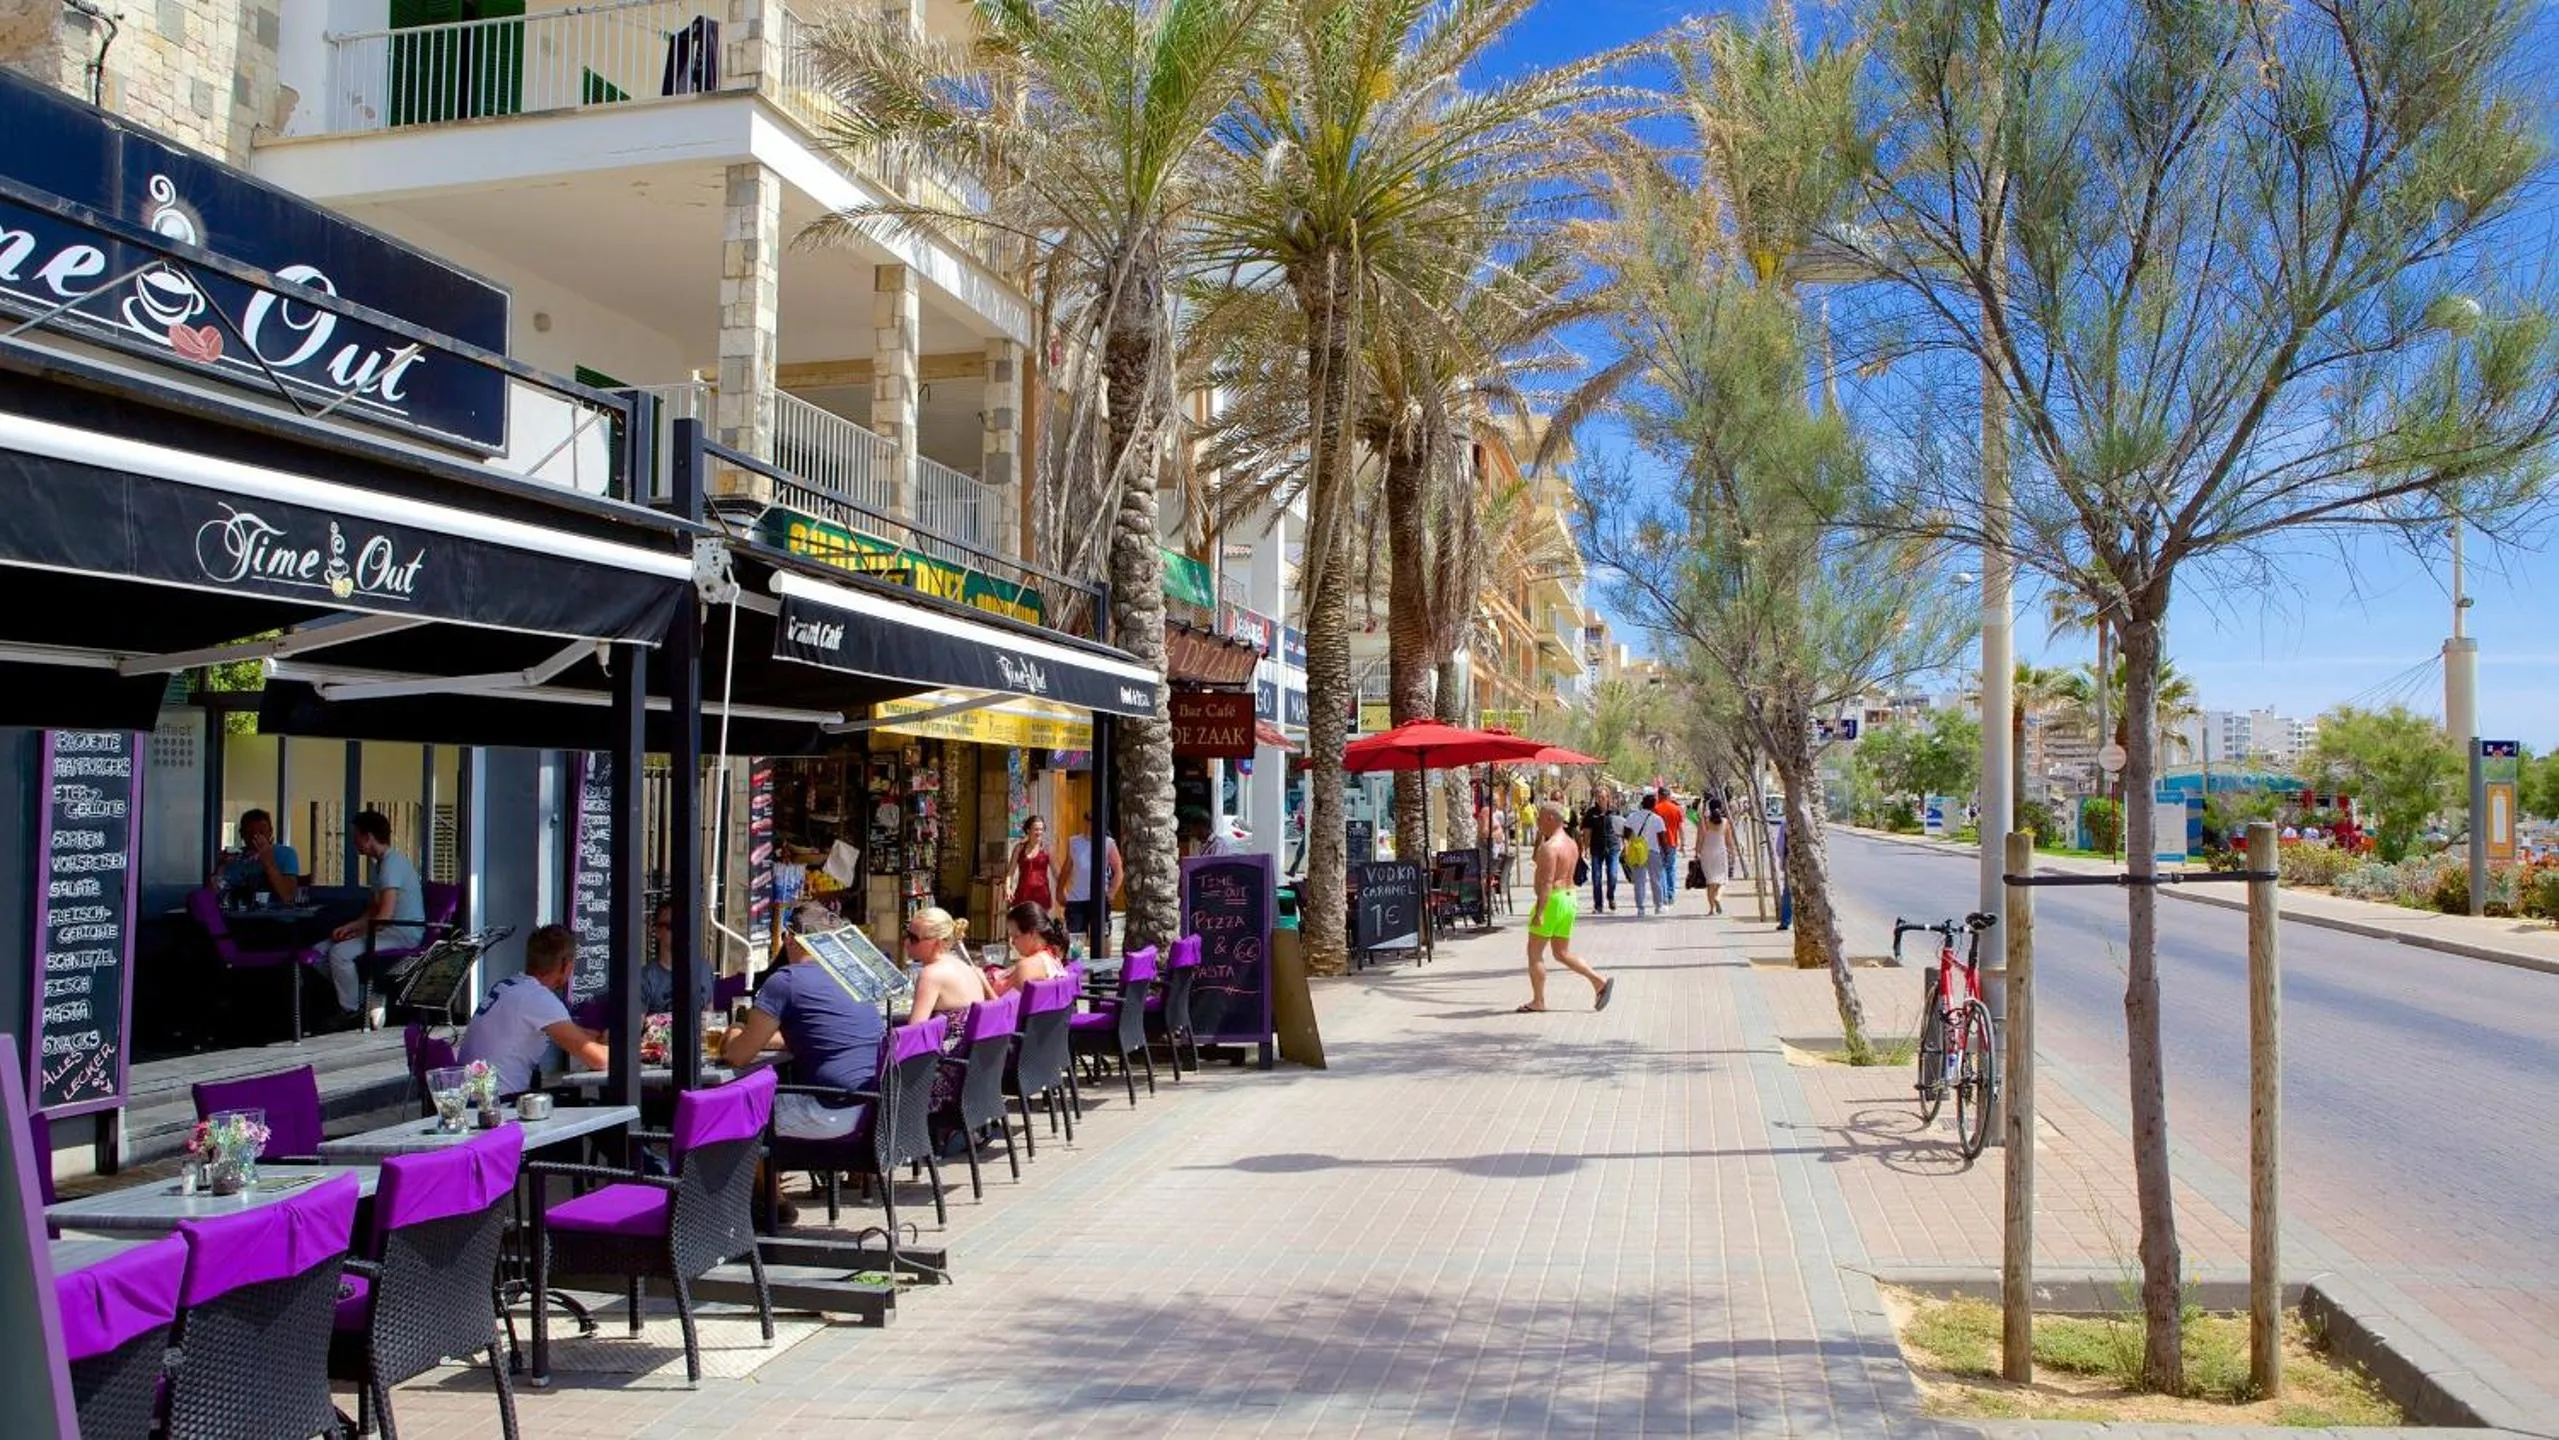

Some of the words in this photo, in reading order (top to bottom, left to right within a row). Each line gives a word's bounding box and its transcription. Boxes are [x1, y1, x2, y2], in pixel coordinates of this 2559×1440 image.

[243, 265, 426, 400] Out
[196, 501, 319, 583] Time
[356, 535, 425, 593] Out
[1180, 703, 1202, 718] Bar
[1205, 702, 1236, 718] Café
[1196, 726, 1247, 746] ZAAK
[1195, 874, 1233, 889] TIME
[1365, 865, 1417, 884] VODKA
[1225, 887, 1247, 898] OUT
[1190, 910, 1246, 930] PIZZA
[1191, 965, 1235, 981] PASTA
[44, 975, 92, 997] FISCH
[42, 999, 92, 1025] PASTA
[41, 1029, 100, 1056] SNACKS
[42, 1051, 84, 1092] ALLES
[62, 1042, 116, 1100] LECKER
